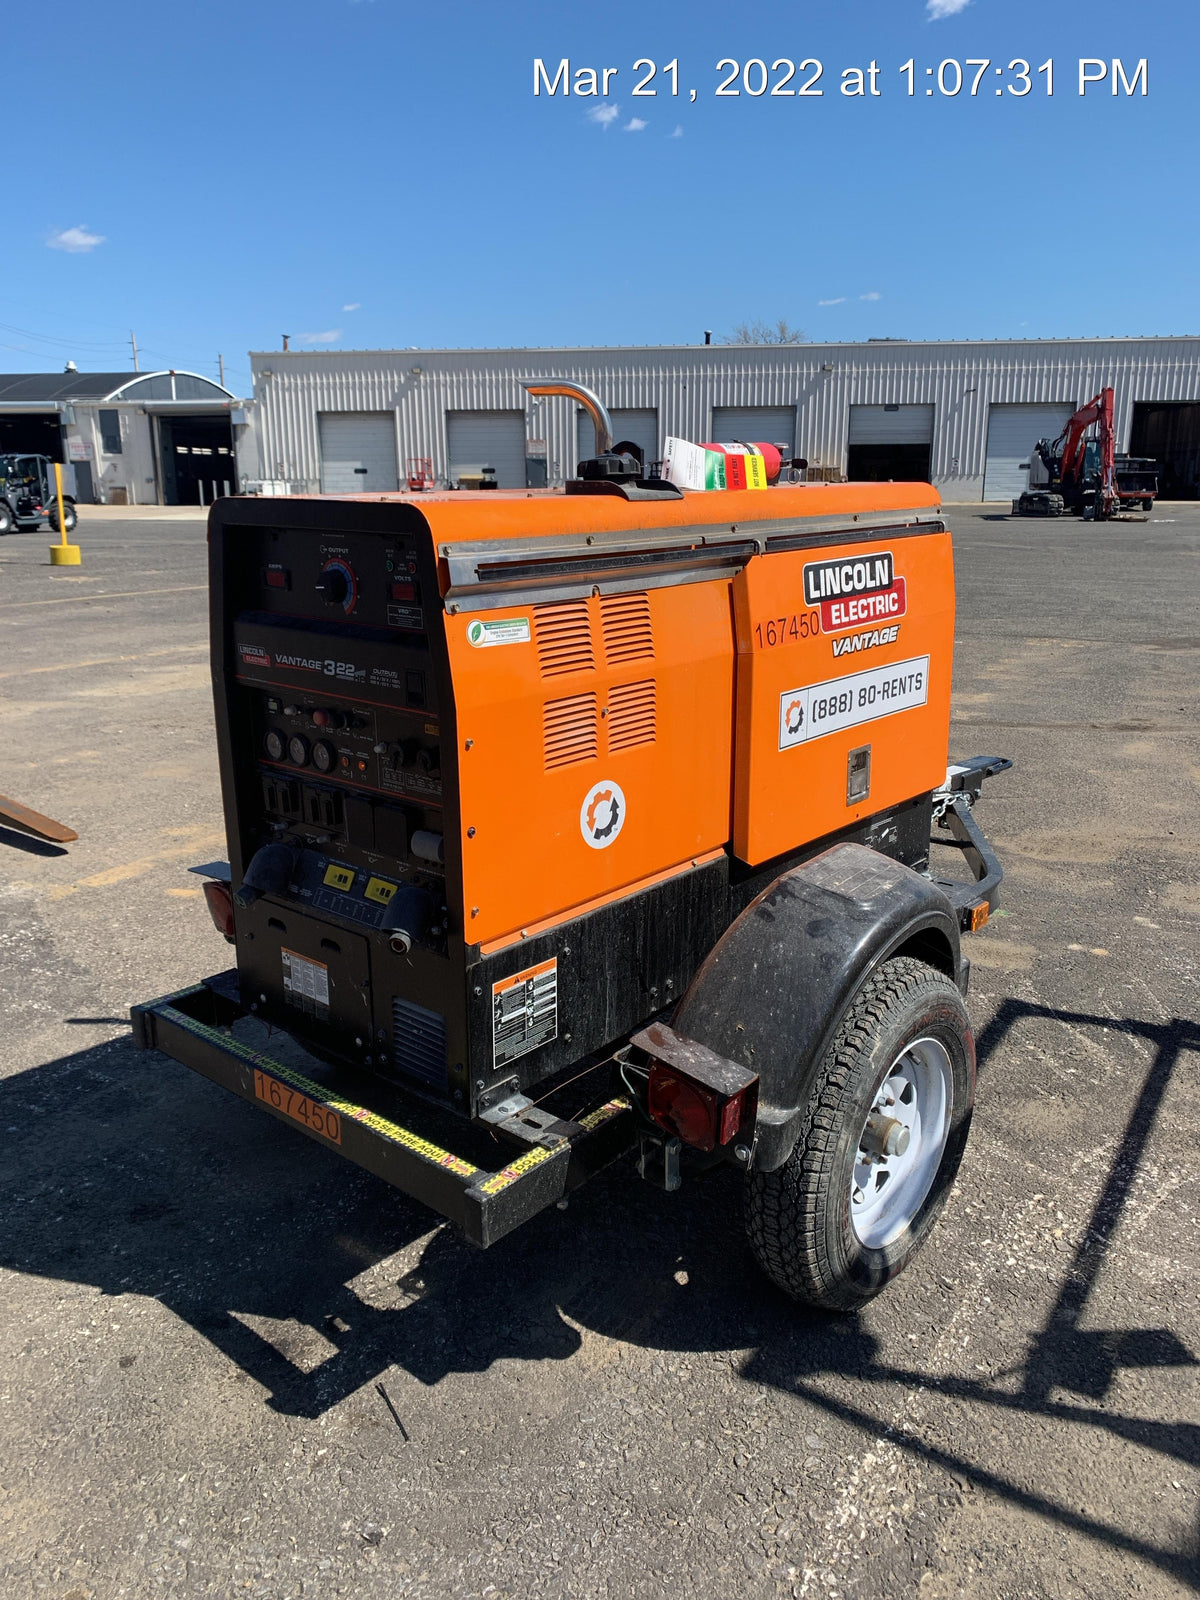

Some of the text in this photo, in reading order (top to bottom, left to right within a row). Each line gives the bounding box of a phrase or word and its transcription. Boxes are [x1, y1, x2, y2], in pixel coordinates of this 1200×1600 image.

[807, 558, 889, 600] LINCOLN
[830, 592, 899, 626] ELECTRIC
[755, 610, 820, 649] 167450
[831, 625, 901, 658] VANTAGE
[239, 645, 265, 657] LINCOLN
[245, 656, 268, 666] ELECTRIC
[275, 653, 356, 677] VANTAGE 322
[812, 671, 923, 724] (888) 80-RENTS
[183, 1019, 252, 1057] DO NOT STAND HERE
[257, 1073, 339, 1140] 167450
[342, 1104, 357, 1113] ICI
[364, 1115, 444, 1160] NO SE PARE AQUÍ
[515, 1159, 533, 1172] DO
